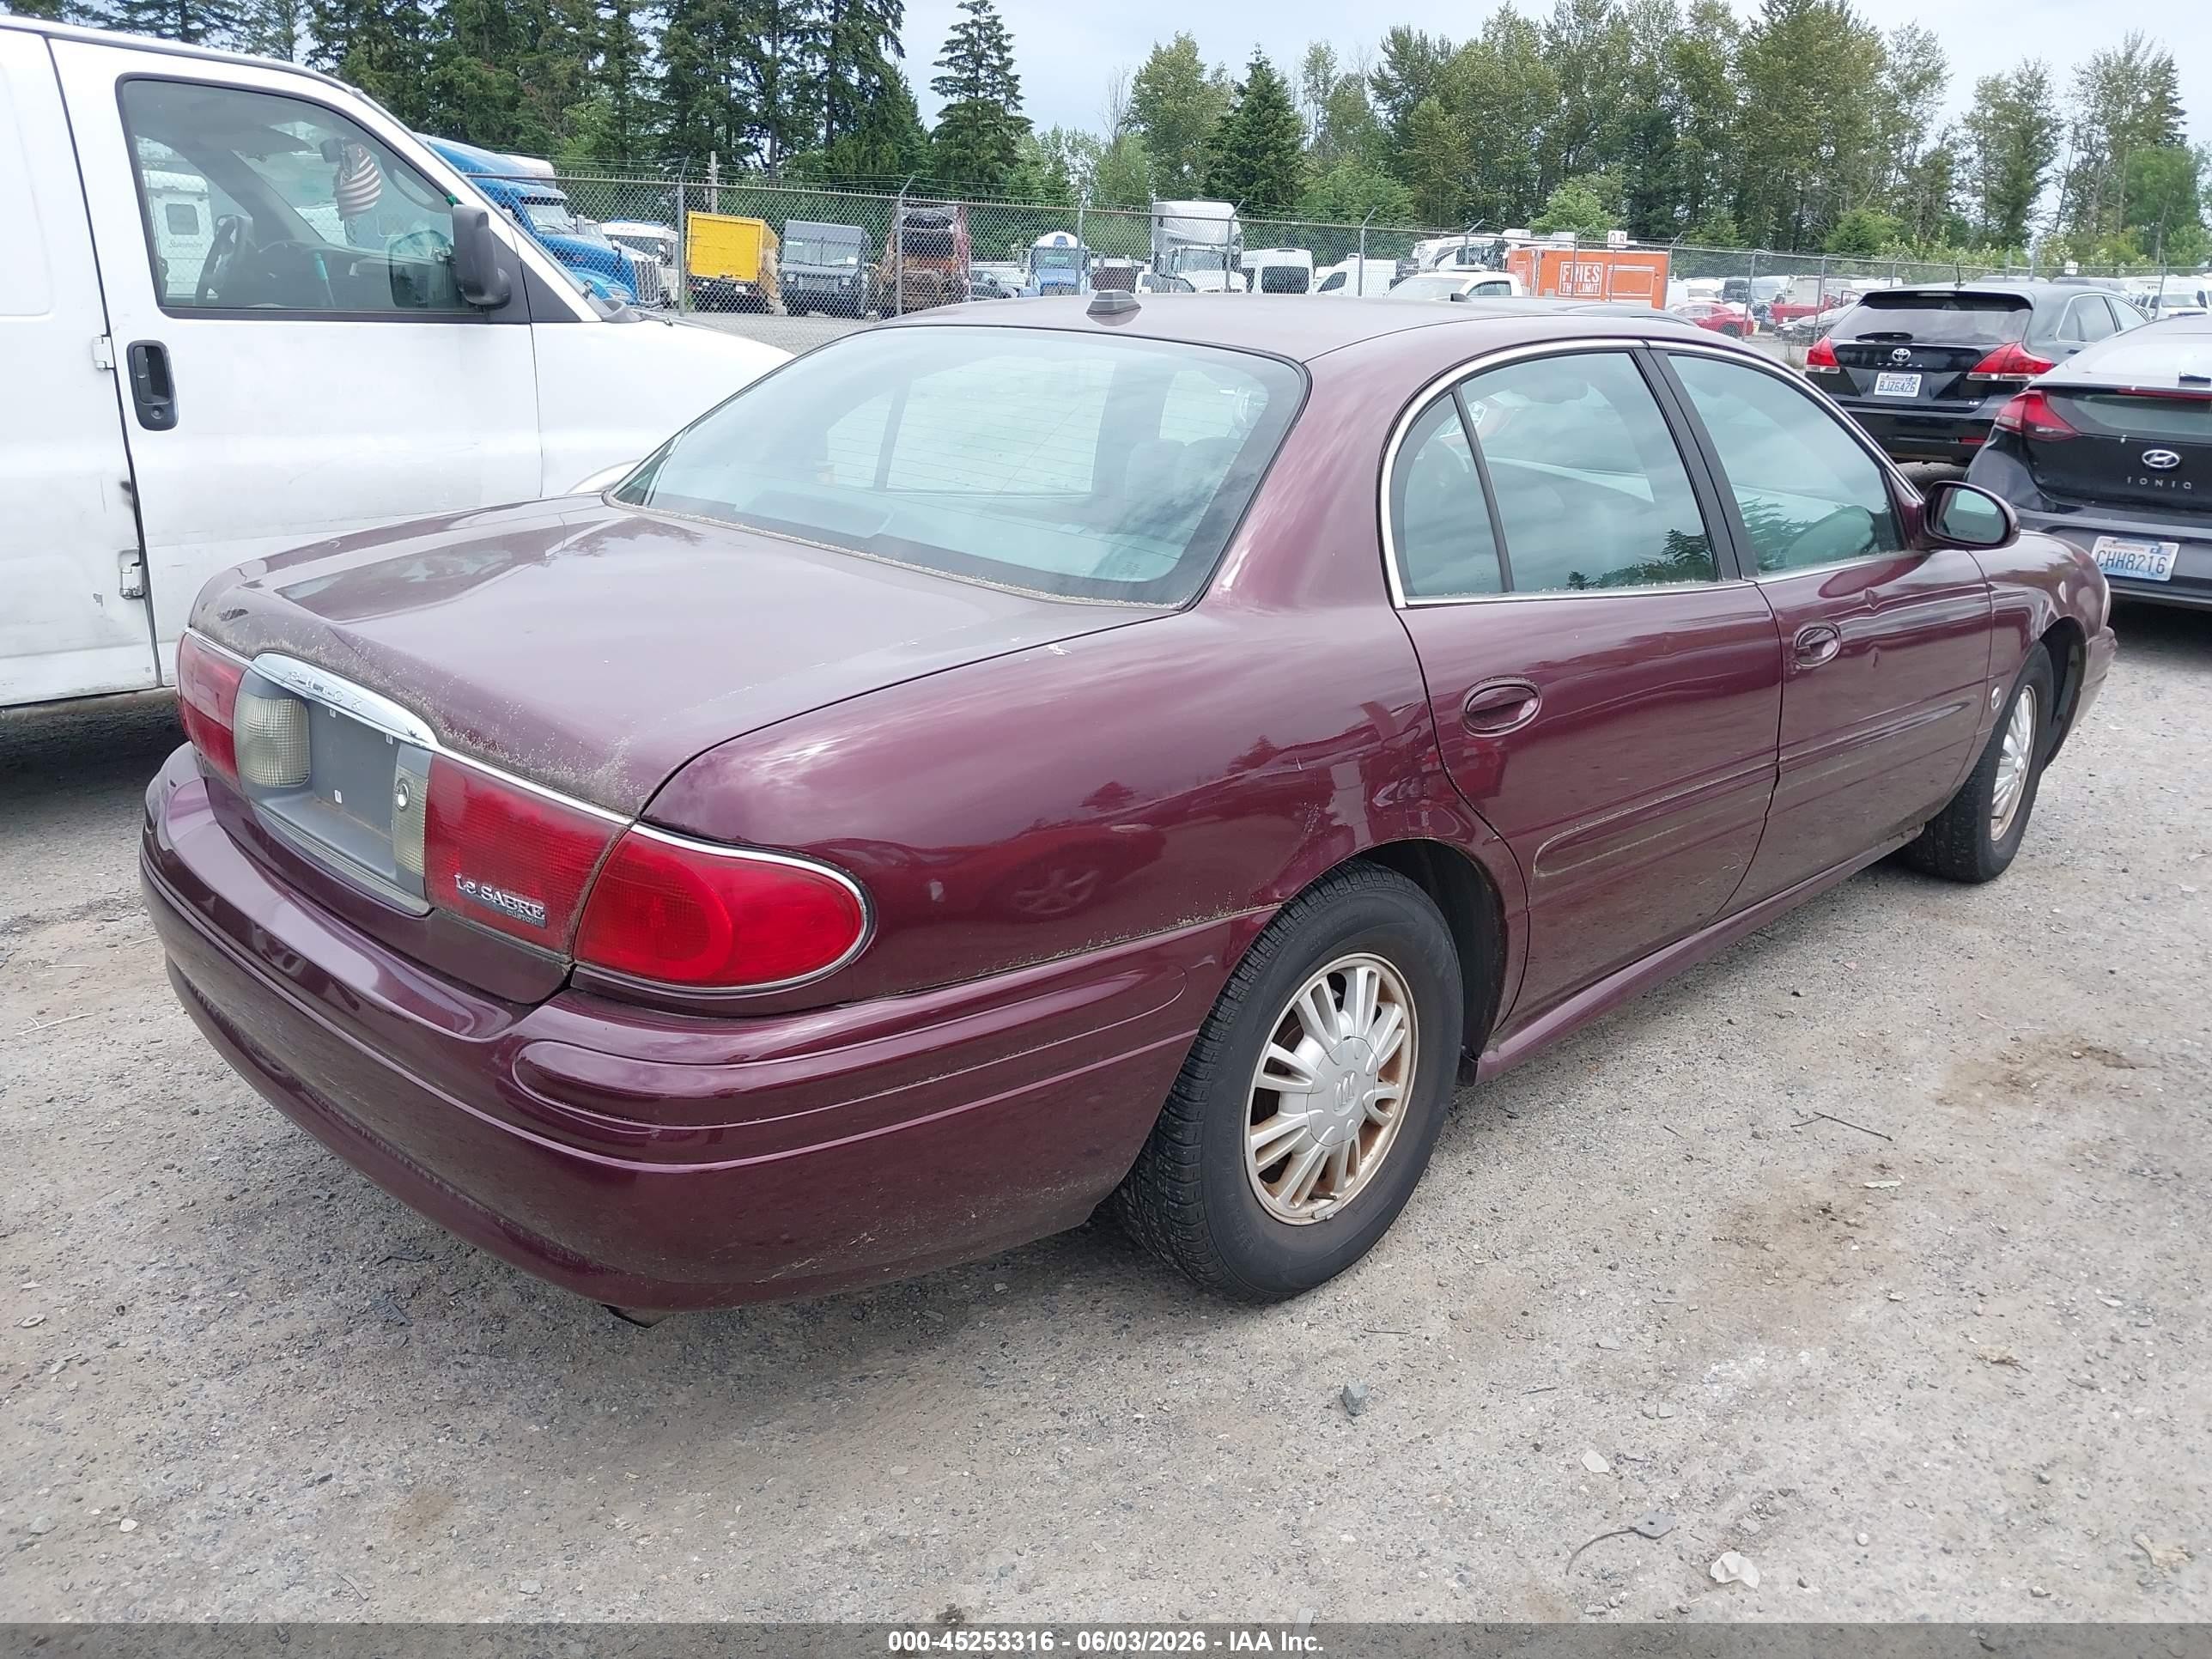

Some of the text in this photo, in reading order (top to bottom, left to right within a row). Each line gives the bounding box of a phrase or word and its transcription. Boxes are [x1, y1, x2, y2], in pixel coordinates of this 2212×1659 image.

[1562, 264, 1600, 283] FRIES
[1578, 283, 1600, 294] LIMIT
[2126, 476, 2192, 489] IONIQ
[2095, 550, 2167, 574] CHH8216
[289, 671, 362, 711] BUICK
[480, 884, 546, 921] SABRE
